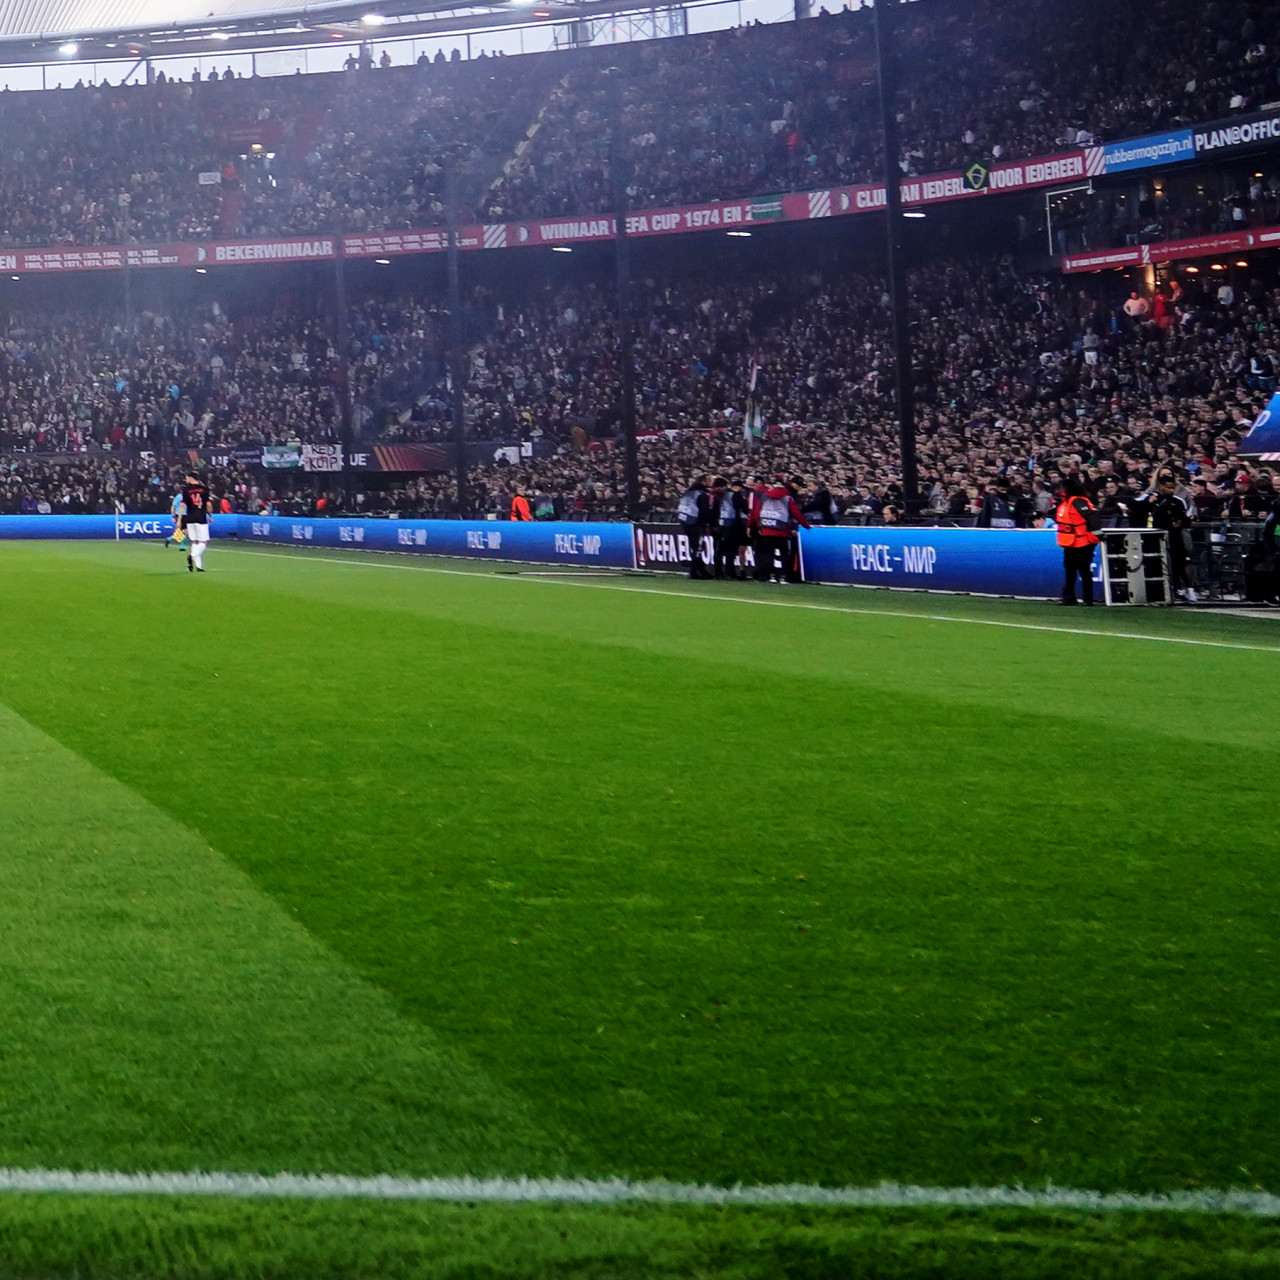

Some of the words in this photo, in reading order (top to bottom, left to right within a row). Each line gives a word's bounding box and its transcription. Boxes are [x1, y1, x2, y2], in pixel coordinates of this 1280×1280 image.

[989, 168, 1023, 189] VOOR
[1024, 156, 1083, 183] IEDEREEN
[540, 219, 609, 240] WINNAAR
[651, 213, 681, 231] CUP
[685, 208, 720, 227] 1974
[723, 205, 742, 223] EN
[215, 241, 333, 261] BEKERWINNAAR
[554, 534, 579, 554] PEACE
[646, 534, 678, 562] UEFA
[851, 544, 893, 572] PEACE
[903, 545, 936, 574] МИР
